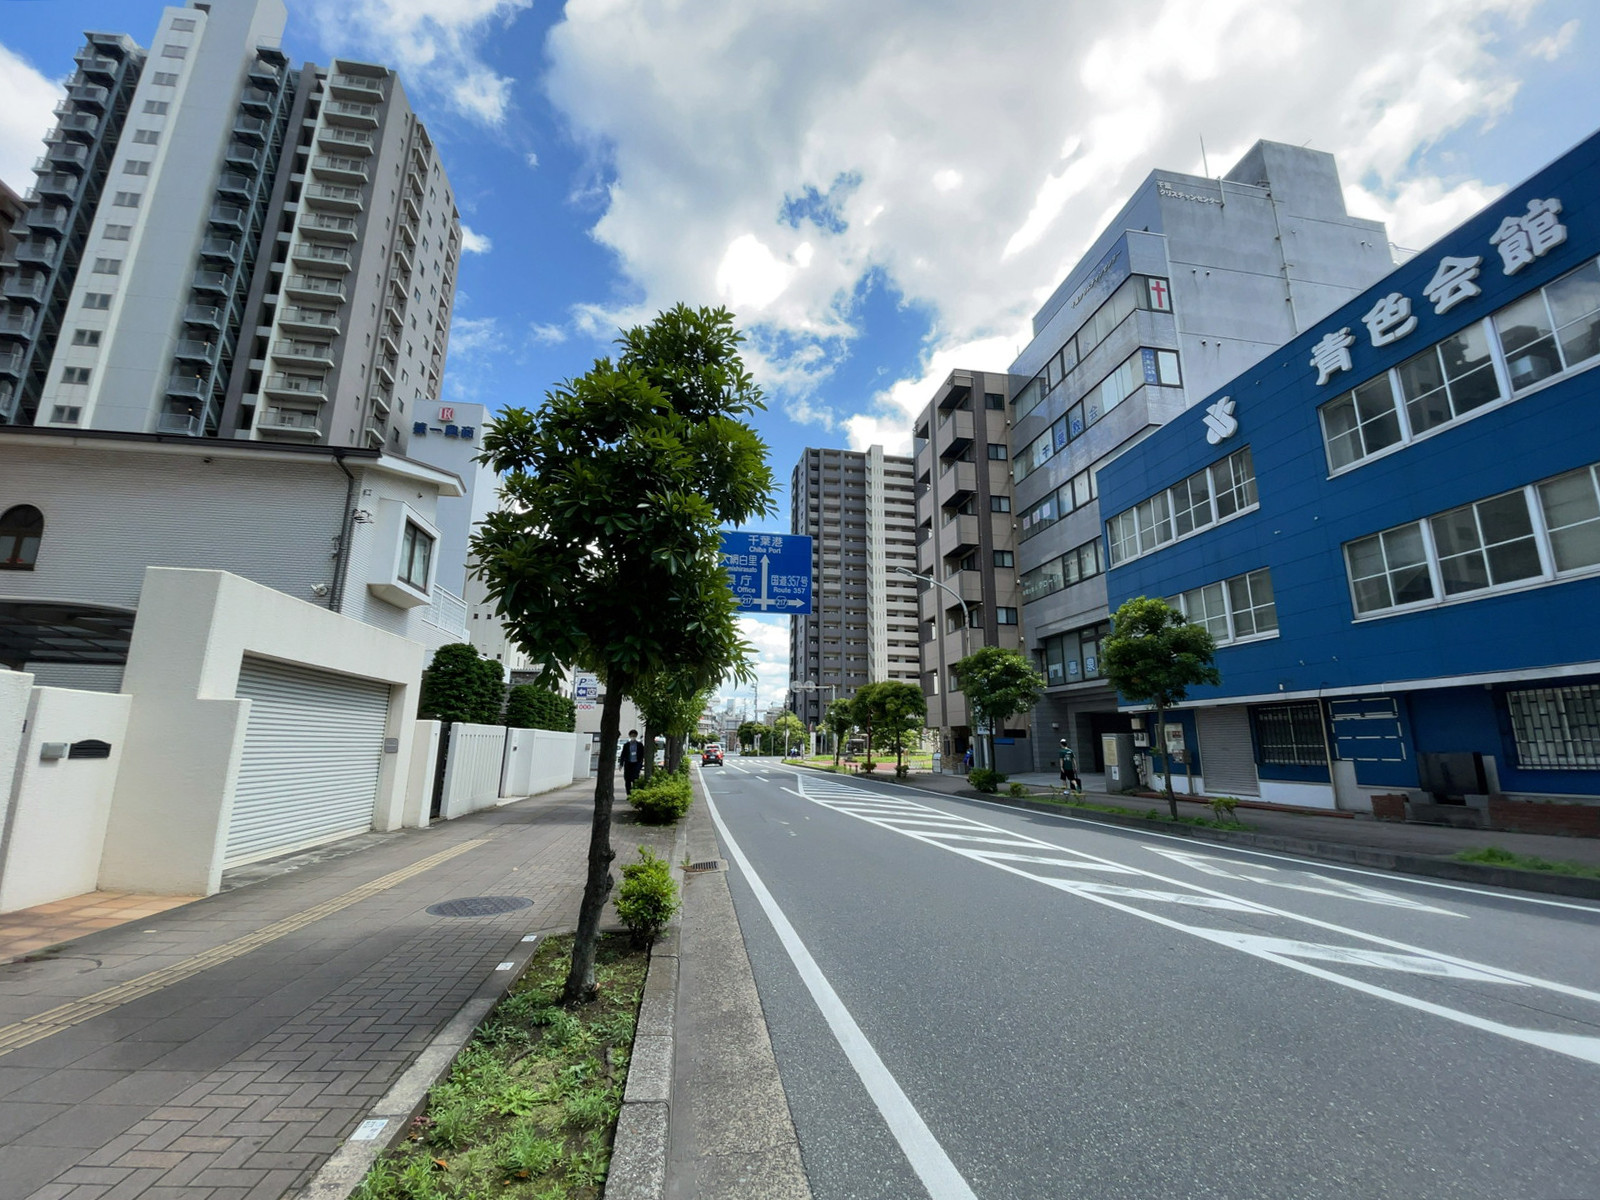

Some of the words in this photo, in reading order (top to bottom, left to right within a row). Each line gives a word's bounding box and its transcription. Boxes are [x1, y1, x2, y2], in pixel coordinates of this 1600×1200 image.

[1310, 198, 1568, 386] 青色会館
[748, 535, 783, 547] 千葉港
[771, 575, 808, 587] 国道357号
[579, 678, 587, 686] P
